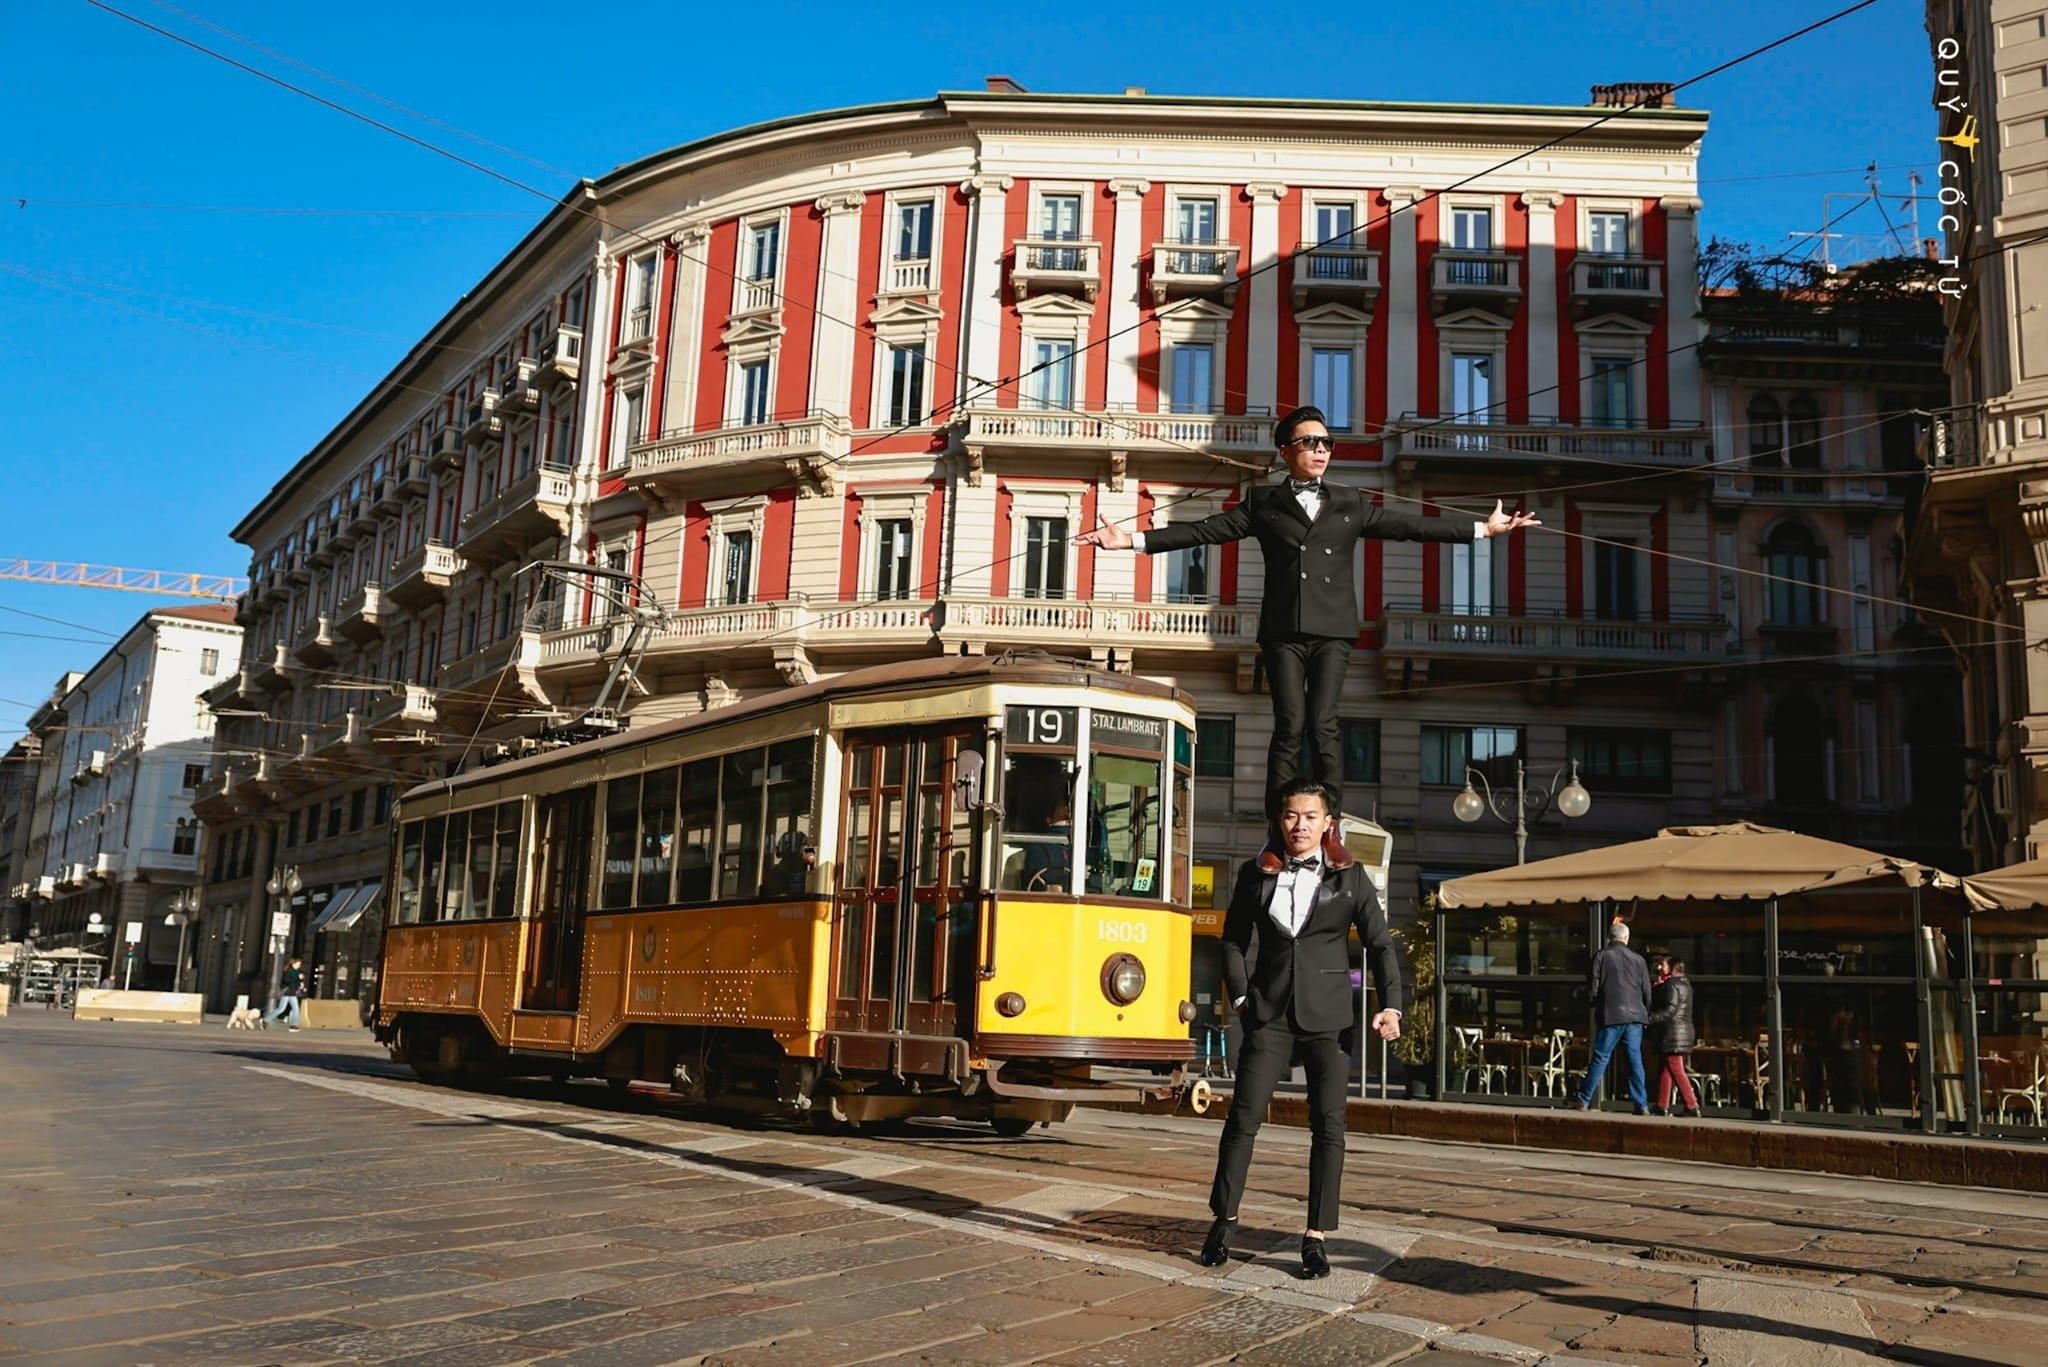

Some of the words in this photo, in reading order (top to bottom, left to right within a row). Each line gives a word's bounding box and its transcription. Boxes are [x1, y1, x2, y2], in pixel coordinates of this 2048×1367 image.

[1027, 709, 1062, 743] 19
[1117, 717, 1160, 736] LAMBRATE
[1137, 879, 1149, 890] 19
[1098, 919, 1148, 943] 1803
